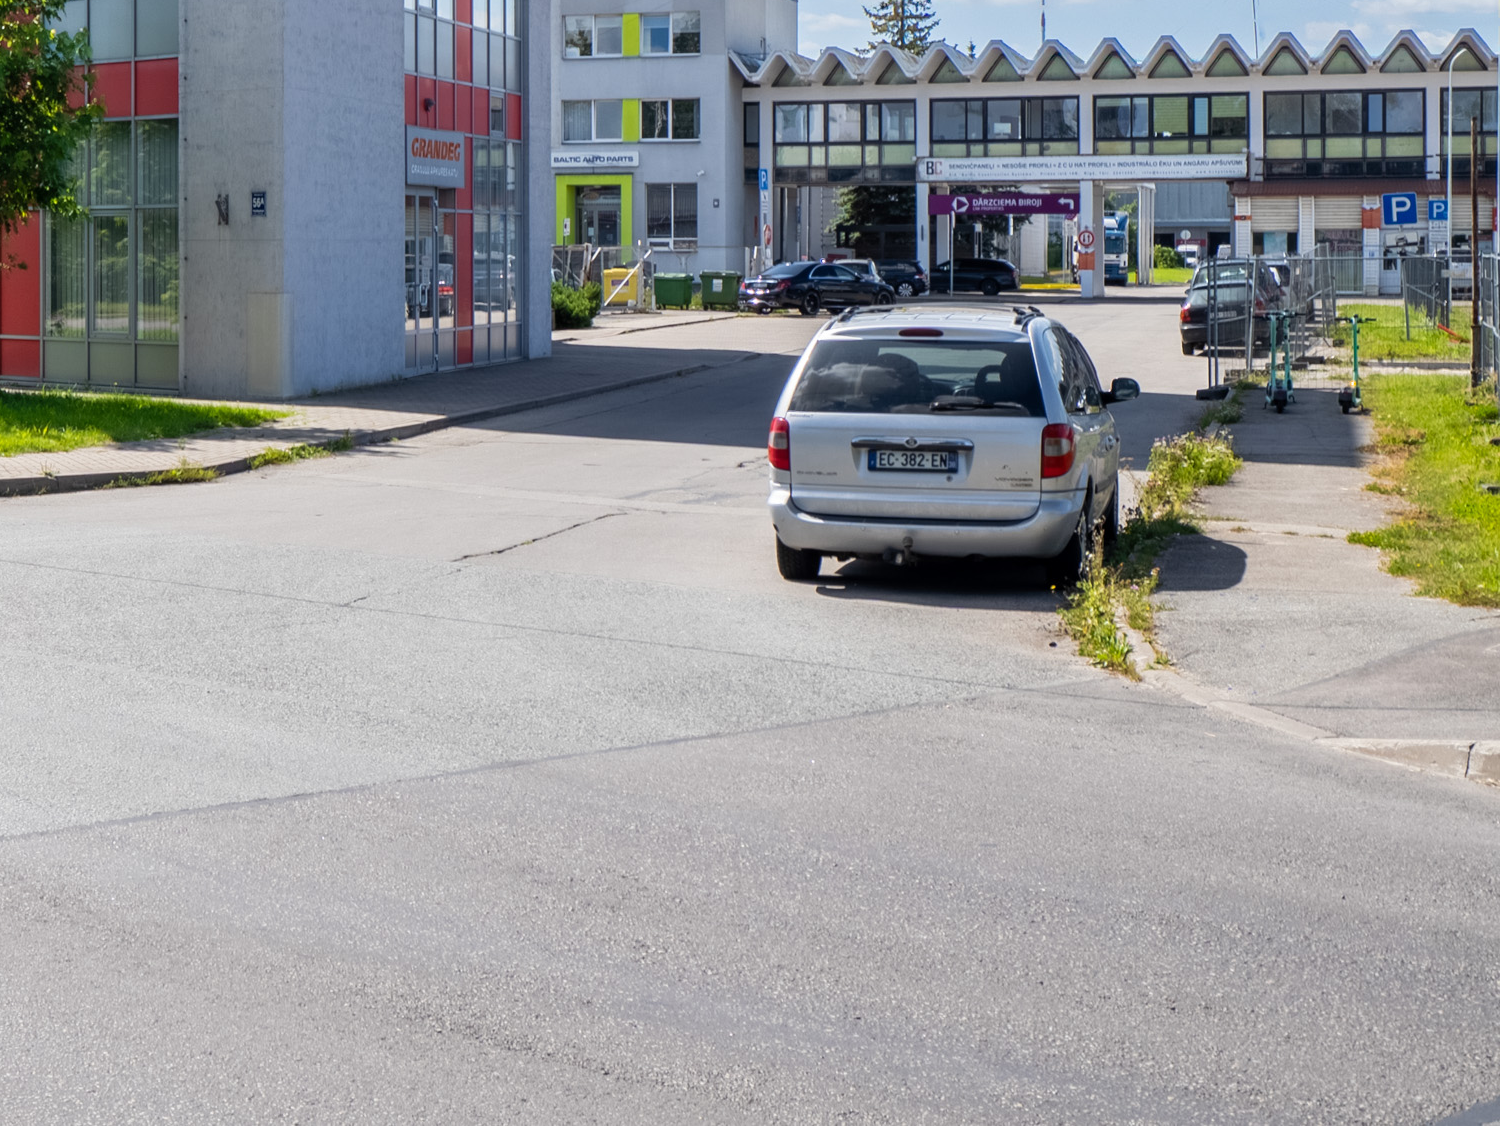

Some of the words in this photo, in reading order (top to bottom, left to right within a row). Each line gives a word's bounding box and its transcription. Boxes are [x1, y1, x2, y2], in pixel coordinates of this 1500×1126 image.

[411, 137, 461, 162] GRANDEG
[553, 156, 580, 164] BALTIC
[583, 155, 605, 163] AUTO
[606, 155, 634, 163] PARTS
[926, 161, 942, 175] BC
[972, 197, 1017, 206] DĀRZCIEMA
[1018, 198, 1042, 207] BIROJI
[1391, 197, 1411, 222] P
[1433, 202, 1445, 218] P
[879, 453, 948, 467] EC-382-EN
